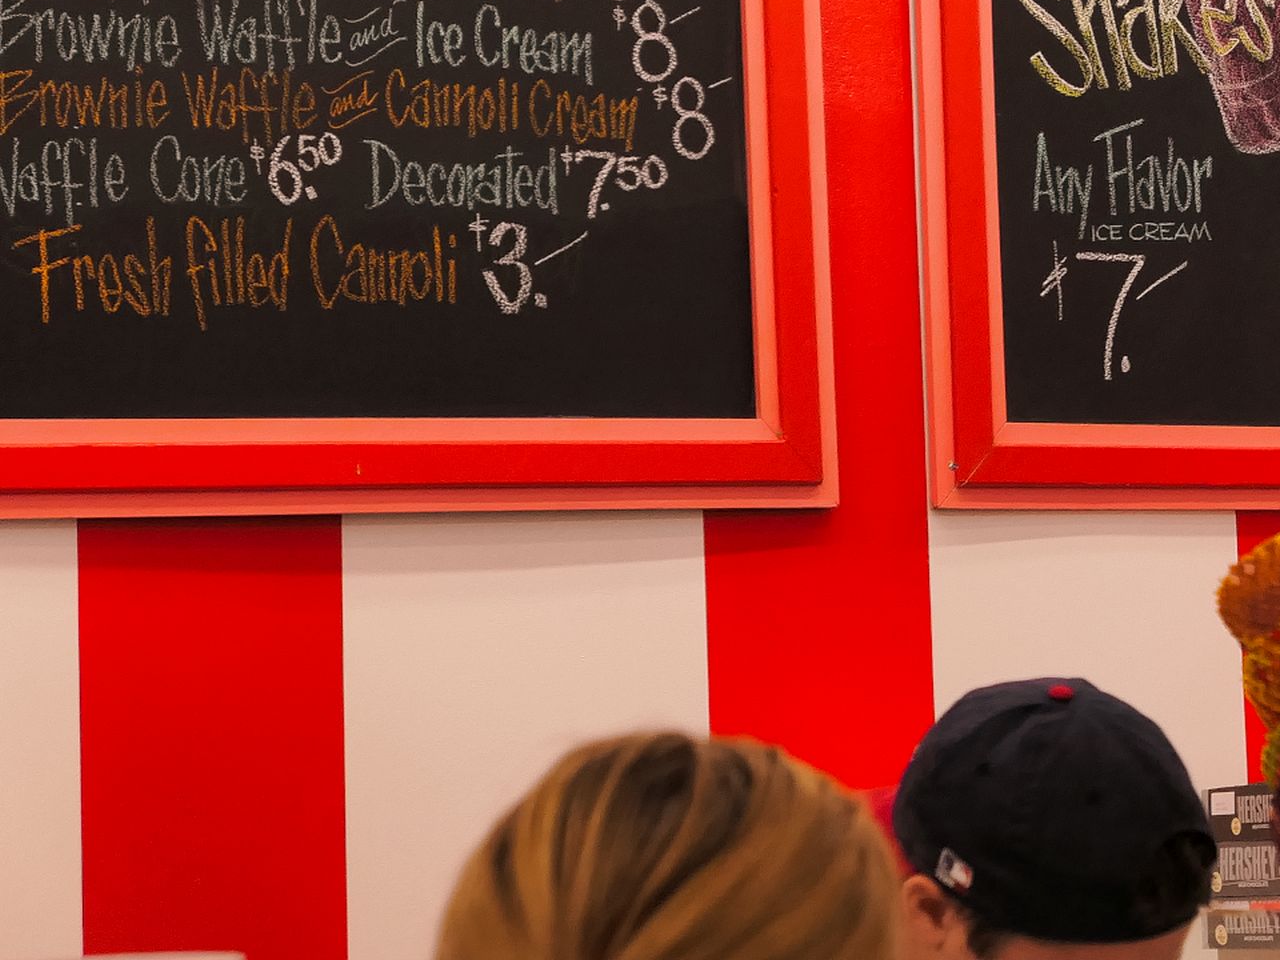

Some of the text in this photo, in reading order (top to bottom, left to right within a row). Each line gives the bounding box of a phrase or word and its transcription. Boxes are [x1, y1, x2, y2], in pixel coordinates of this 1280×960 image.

[350, 0, 405, 52] and
[415, 0, 466, 68] Ice
[475, 4, 593, 86] Cream
[0, 65, 171, 135] Brownie
[182, 66, 319, 144] Waffle
[330, 80, 379, 118] and
[385, 69, 519, 138] Cannoli
[530, 79, 638, 152] Cream
[150, 135, 248, 206] Cone
[363, 139, 559, 215] Decorated
[1033, 119, 1213, 239] Any Flavor
[10, 216, 172, 324] Fresh
[186, 215, 294, 331] filled
[310, 214, 457, 310] Cannoli
[1092, 222, 1213, 242] ICE CREAM
